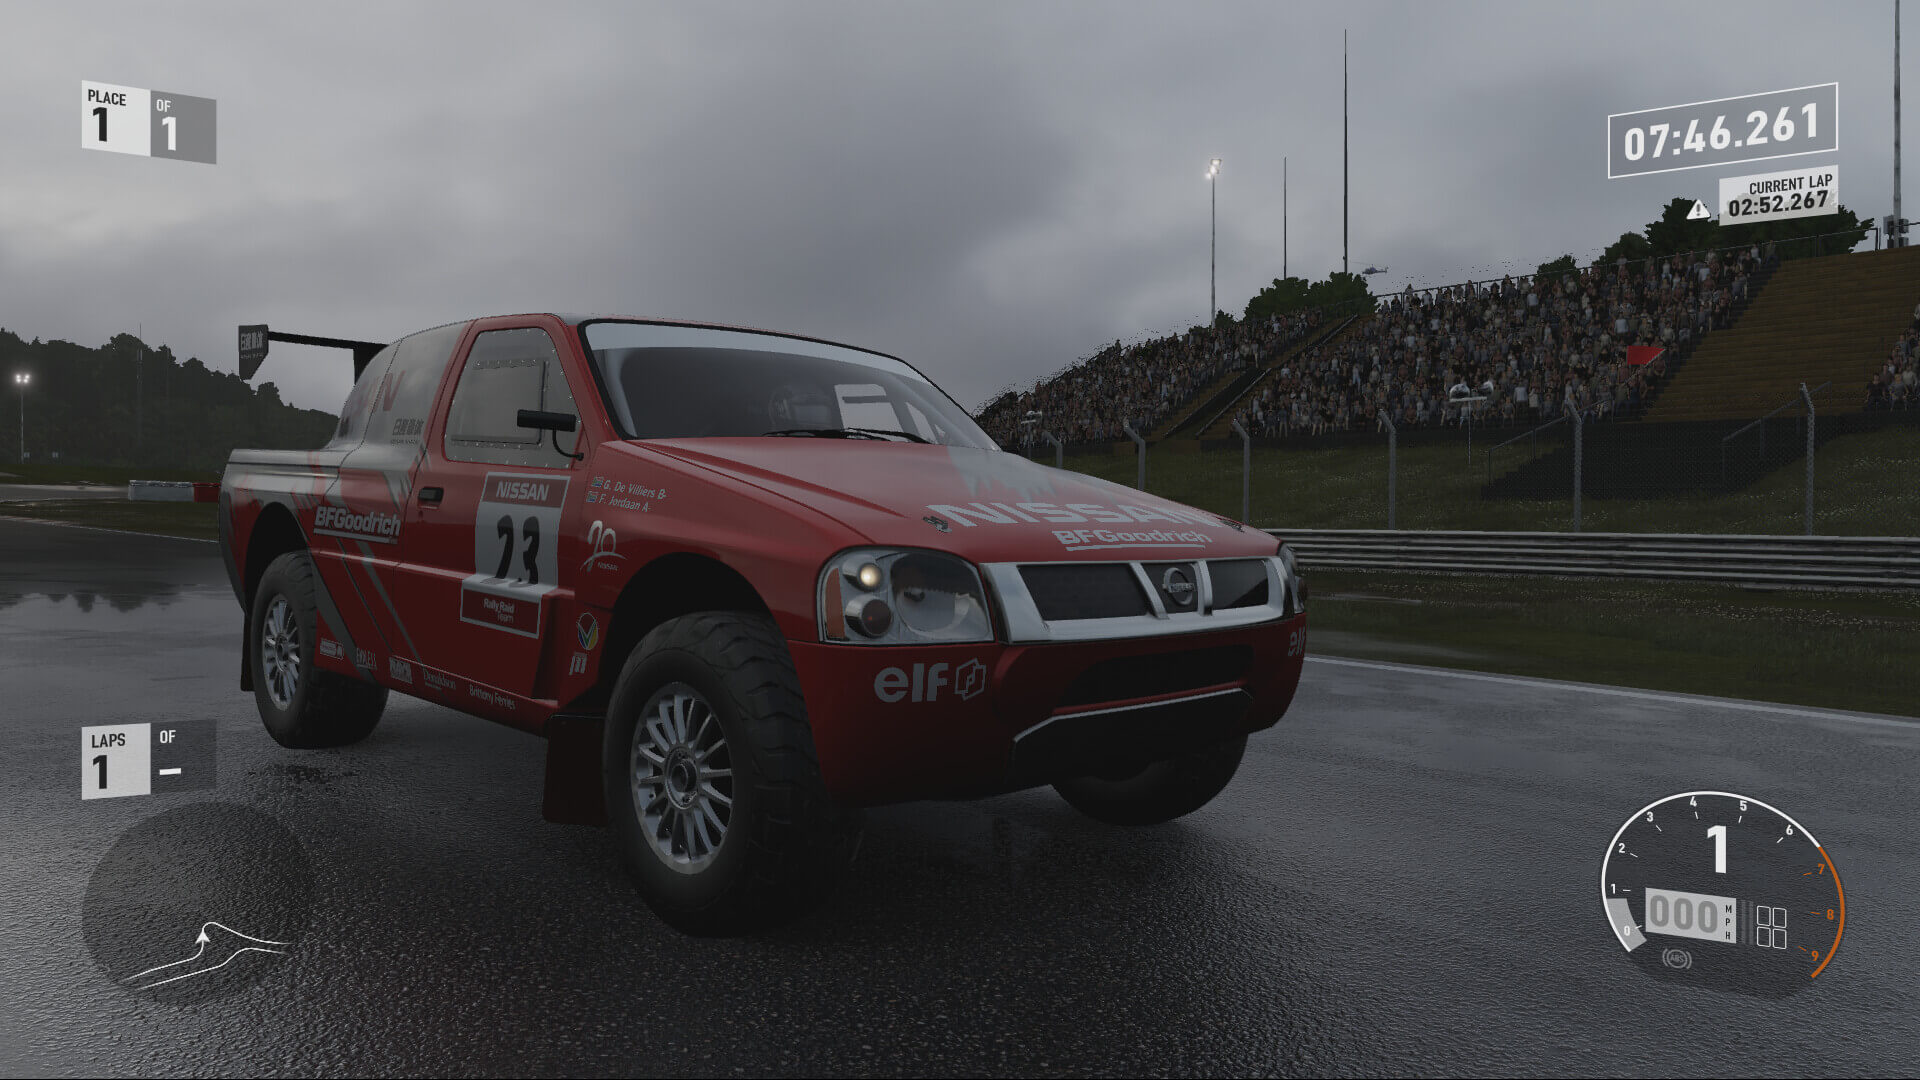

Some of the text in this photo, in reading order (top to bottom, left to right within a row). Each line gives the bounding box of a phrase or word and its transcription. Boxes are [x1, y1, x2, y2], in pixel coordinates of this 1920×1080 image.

[496, 481, 549, 501] NISSAN
[603, 479, 612, 490] G.
[615, 481, 625, 493] De
[628, 483, 655, 498] Villiers
[599, 493, 606, 504] F.
[608, 496, 640, 511] Jordaan
[314, 505, 402, 537] BFGoodrich
[925, 502, 1225, 528] NISSAN
[1052, 529, 1213, 546] BFGoodrich
[481, 514, 540, 588] 23
[483, 598, 515, 614] Rally Raid
[497, 611, 514, 624] Team
[874, 662, 949, 703] elf
